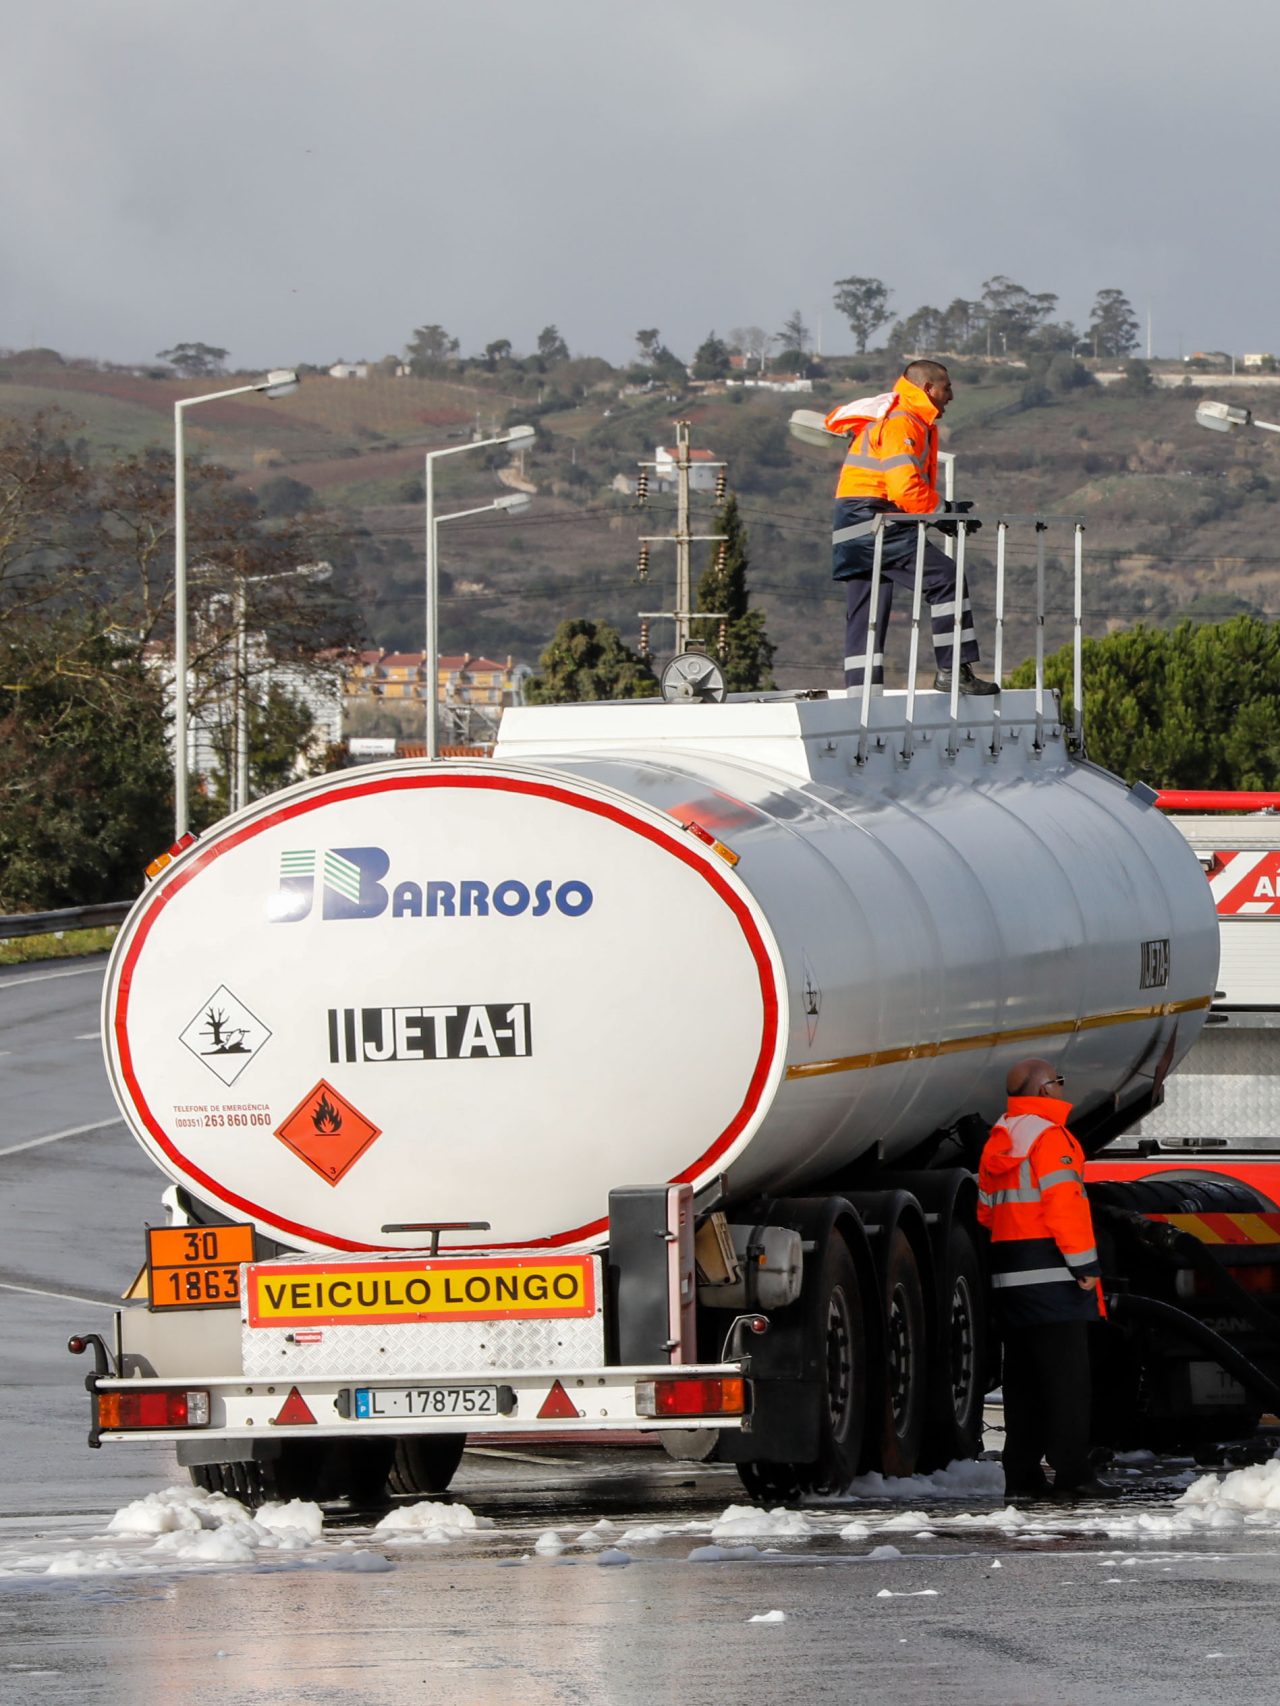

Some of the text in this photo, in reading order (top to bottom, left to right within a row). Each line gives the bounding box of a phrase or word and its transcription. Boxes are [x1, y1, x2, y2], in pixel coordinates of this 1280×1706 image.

[175, 1113, 271, 1128] (00351) 263 860 060
[183, 1232, 218, 1261] 30
[169, 1269, 239, 1300] 1863
[264, 1273, 579, 1309] VEICULO LONGO
[372, 1390, 491, 1414] L 178752
